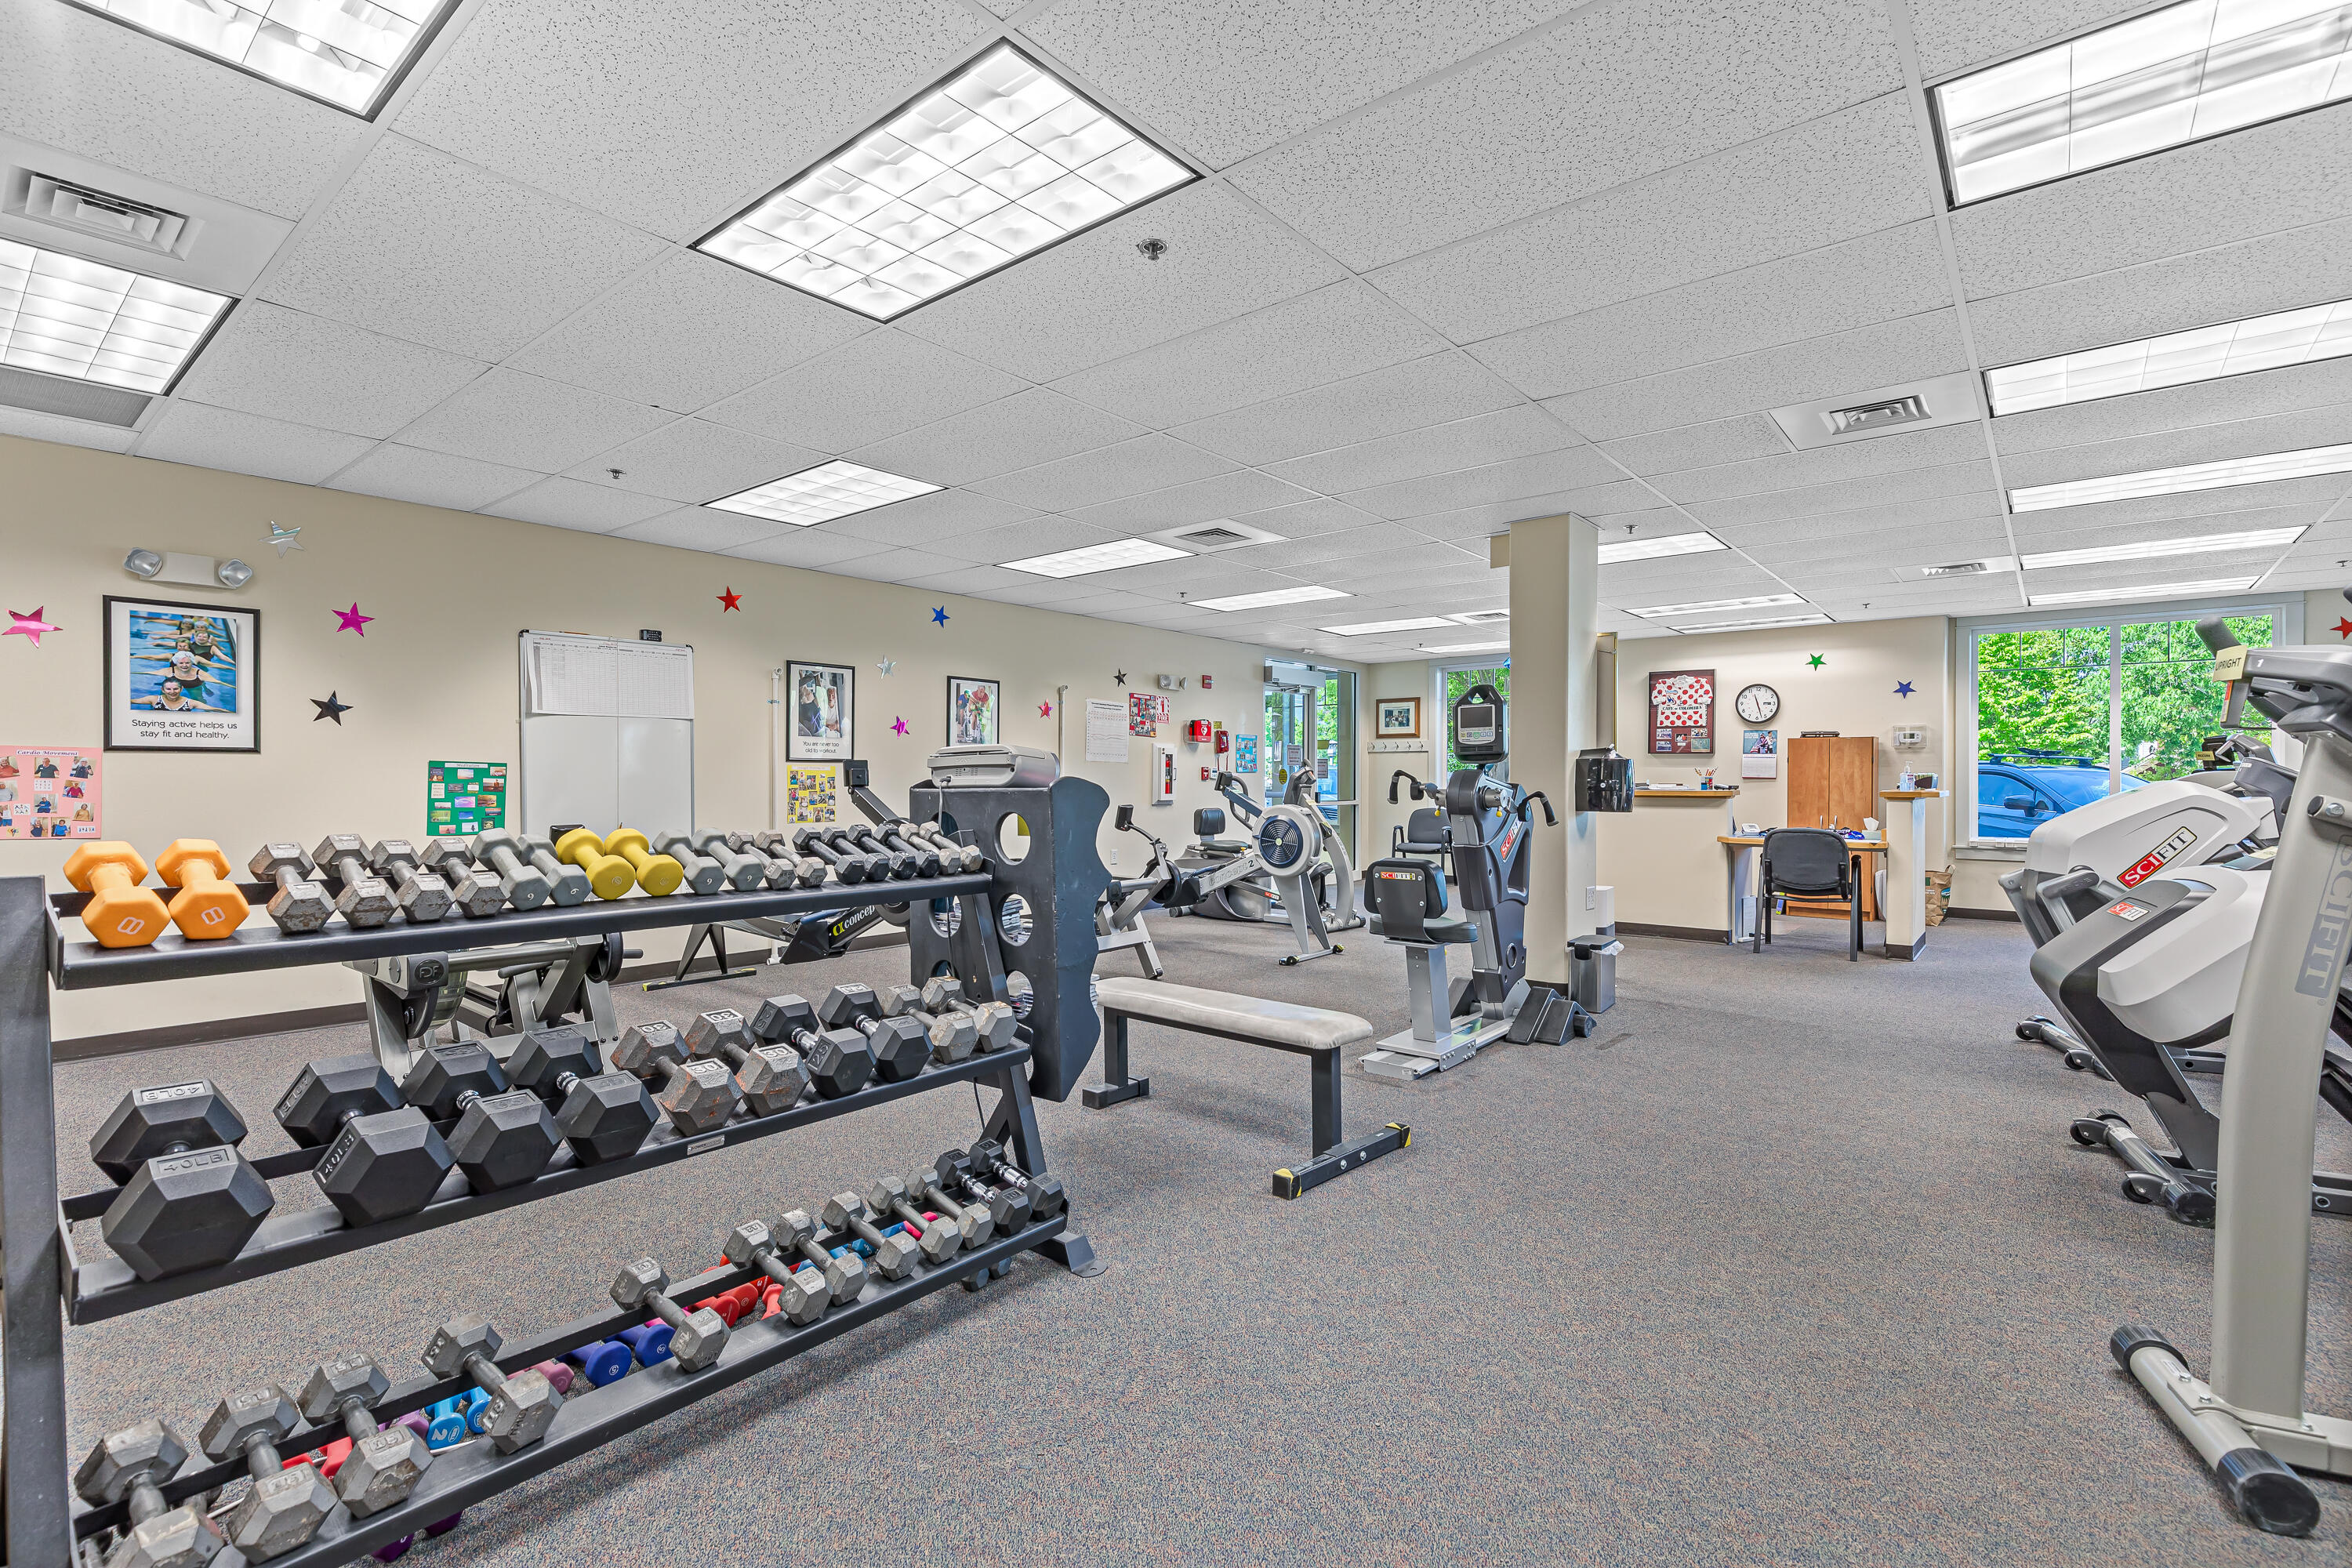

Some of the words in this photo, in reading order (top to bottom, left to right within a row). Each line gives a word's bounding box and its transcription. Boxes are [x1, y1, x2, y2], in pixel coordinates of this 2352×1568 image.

[2215, 657, 2242, 671] UPRIGHT
[2257, 659, 2264, 668] 1
[132, 719, 165, 729] Staying
[140, 730, 159, 739] stay
[195, 731, 230, 740] healthy.
[2125, 832, 2187, 884] SCIFIT
[1247, 859, 1254, 868] 2
[201, 906, 226, 926] 8
[117, 916, 145, 935] 8
[710, 1012, 735, 1022] 30
[641, 1023, 667, 1033] 30
[764, 1047, 789, 1058] 30
[691, 1064, 719, 1074] 30
[146, 1087, 200, 1100] 40LB
[163, 1154, 223, 1171] 40LB
